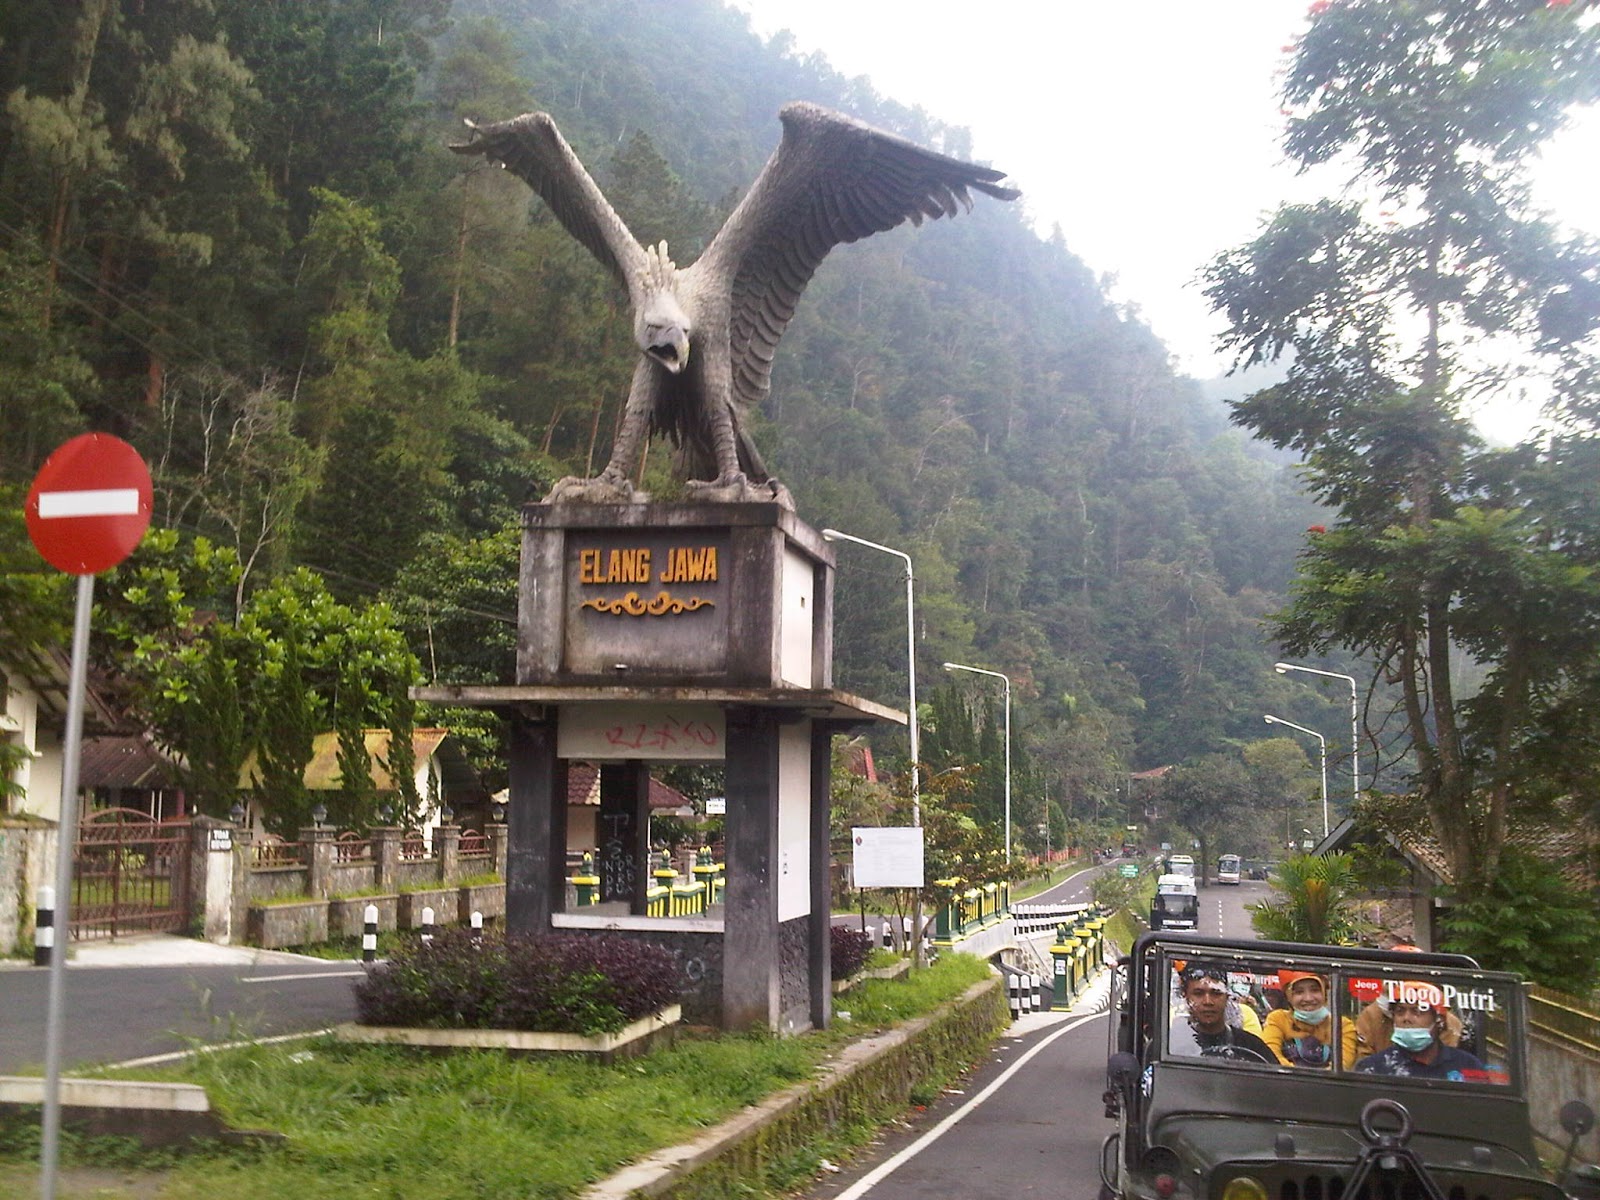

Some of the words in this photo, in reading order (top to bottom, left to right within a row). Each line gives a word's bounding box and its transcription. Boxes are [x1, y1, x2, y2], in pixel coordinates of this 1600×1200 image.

[579, 548, 651, 584] ELANG
[659, 546, 718, 583] JAWA
[1354, 980, 1379, 991] Jeep
[1382, 979, 1441, 1012] Tlogo
[1441, 983, 1495, 1012] Putri
